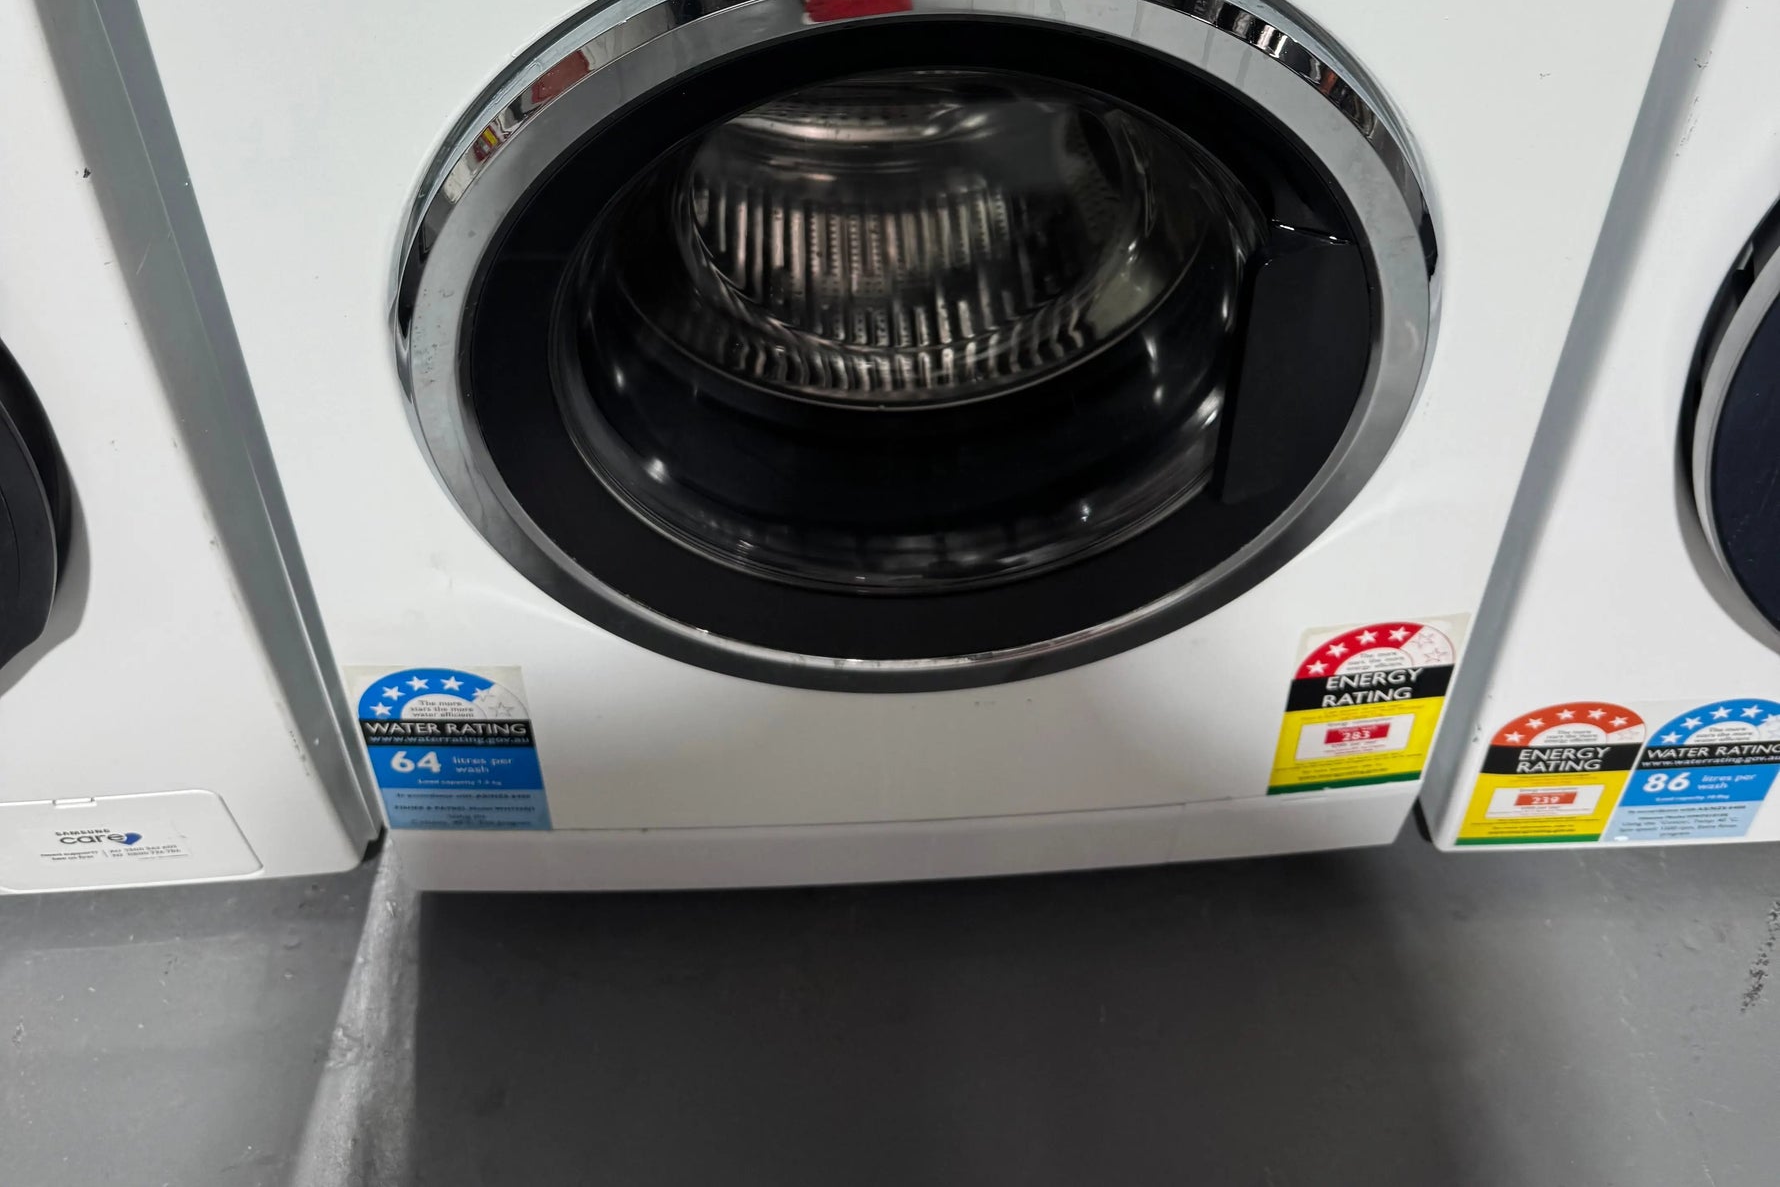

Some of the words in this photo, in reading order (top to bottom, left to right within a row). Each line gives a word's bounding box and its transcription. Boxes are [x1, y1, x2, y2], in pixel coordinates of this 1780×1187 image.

[1327, 668, 1423, 690] ENERGY
[1323, 687, 1412, 707] RATING
[365, 722, 441, 735] WATER
[445, 722, 527, 735] RATING
[1519, 747, 1611, 761] ENERGY
[1647, 747, 1710, 759] WATER
[390, 750, 442, 773] 64
[1517, 760, 1601, 773] RATING
[1642, 771, 1691, 793] 86
[1702, 773, 1732, 783] litres
[60, 833, 126, 845] care
